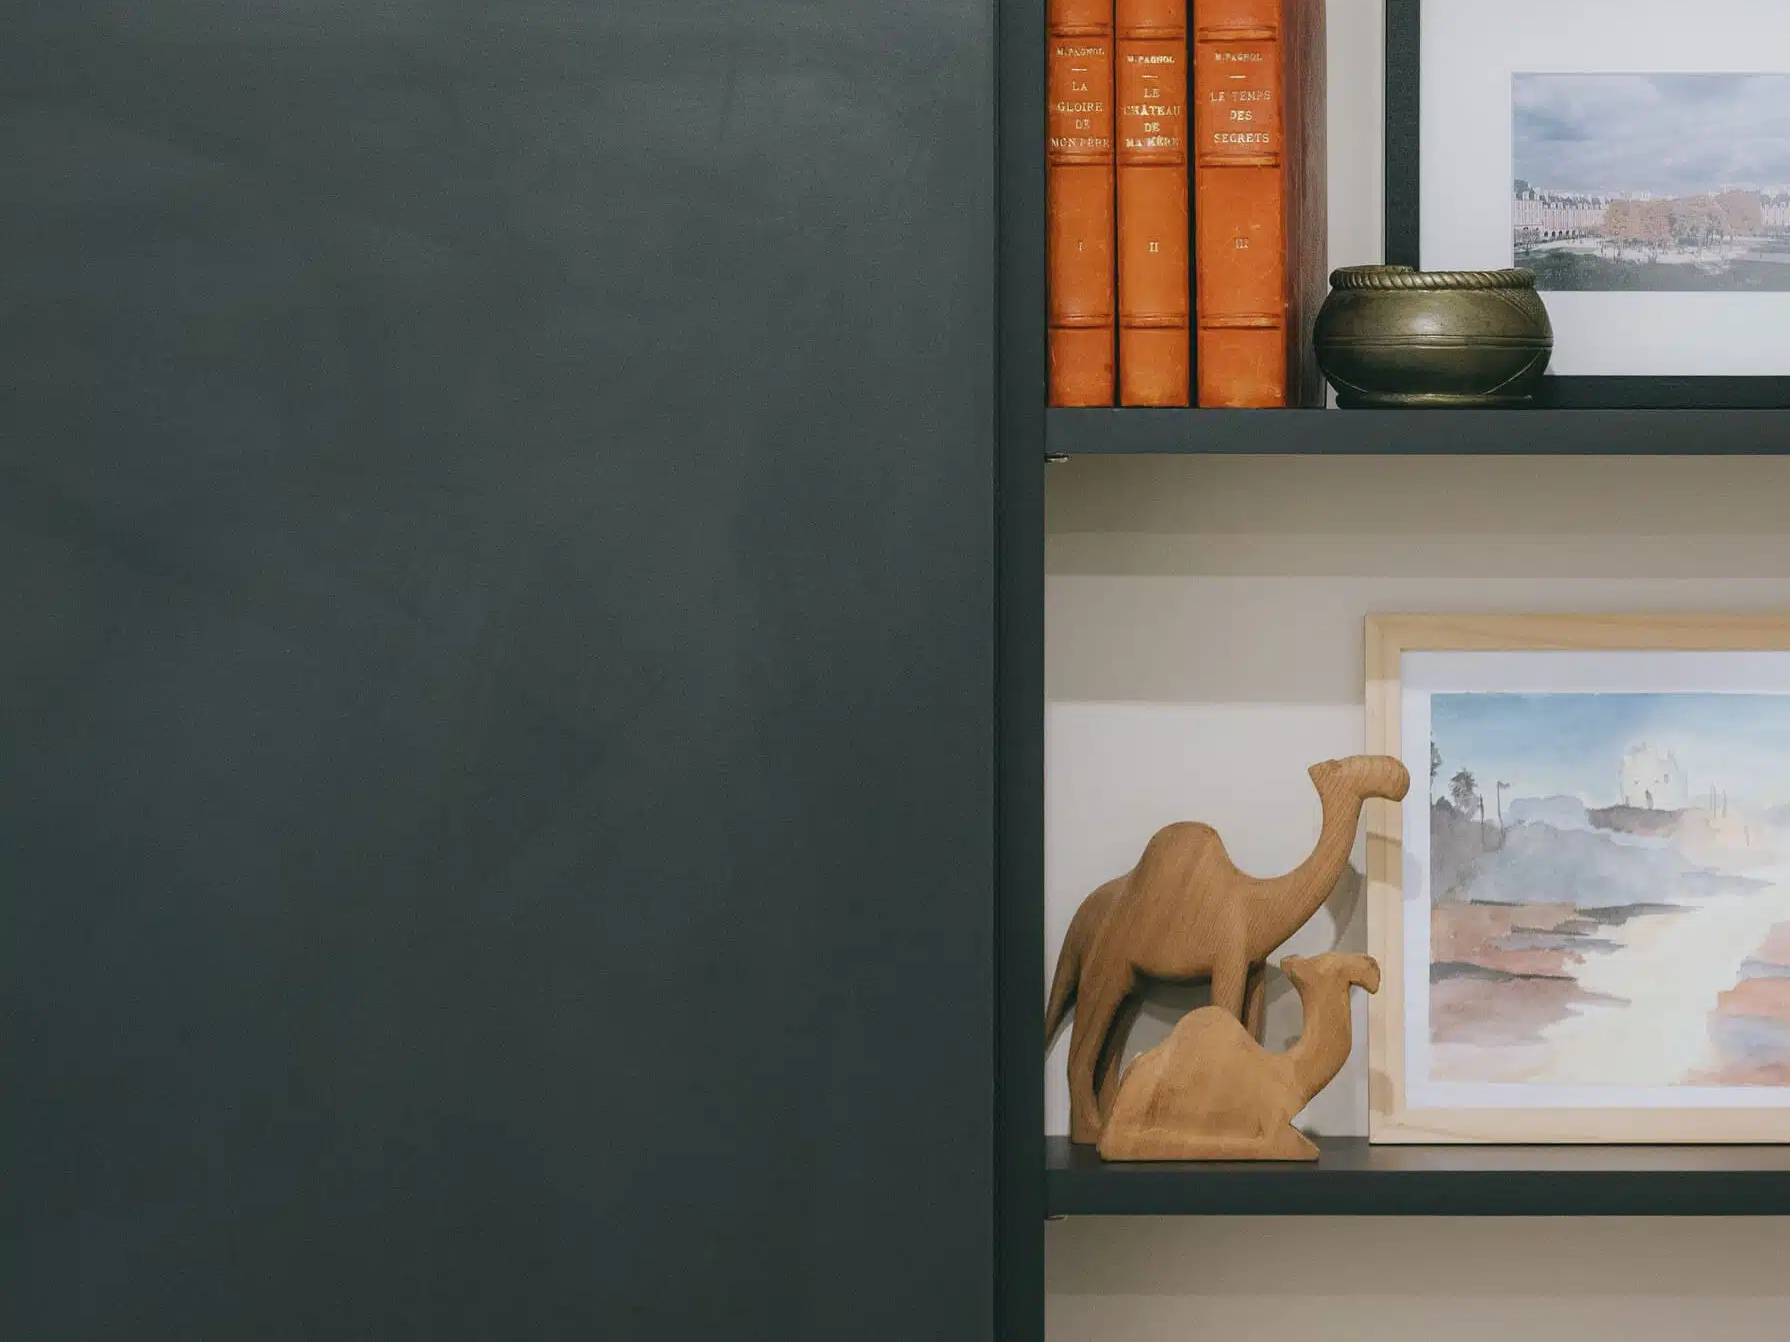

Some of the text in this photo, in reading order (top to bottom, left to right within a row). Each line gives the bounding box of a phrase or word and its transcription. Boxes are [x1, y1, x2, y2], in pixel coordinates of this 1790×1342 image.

[1072, 81, 1088, 91] LA
[1144, 88, 1160, 98] LE
[1210, 89, 1271, 102] LE TEMPS
[1057, 102, 1103, 113] GLOIRE
[1231, 110, 1253, 121] DES
[1075, 119, 1091, 130] DE
[1144, 122, 1160, 132] DE
[1051, 138, 1076, 147] MON
[1213, 133, 1270, 144] SECRETS
[1149, 242, 1159, 252] II
